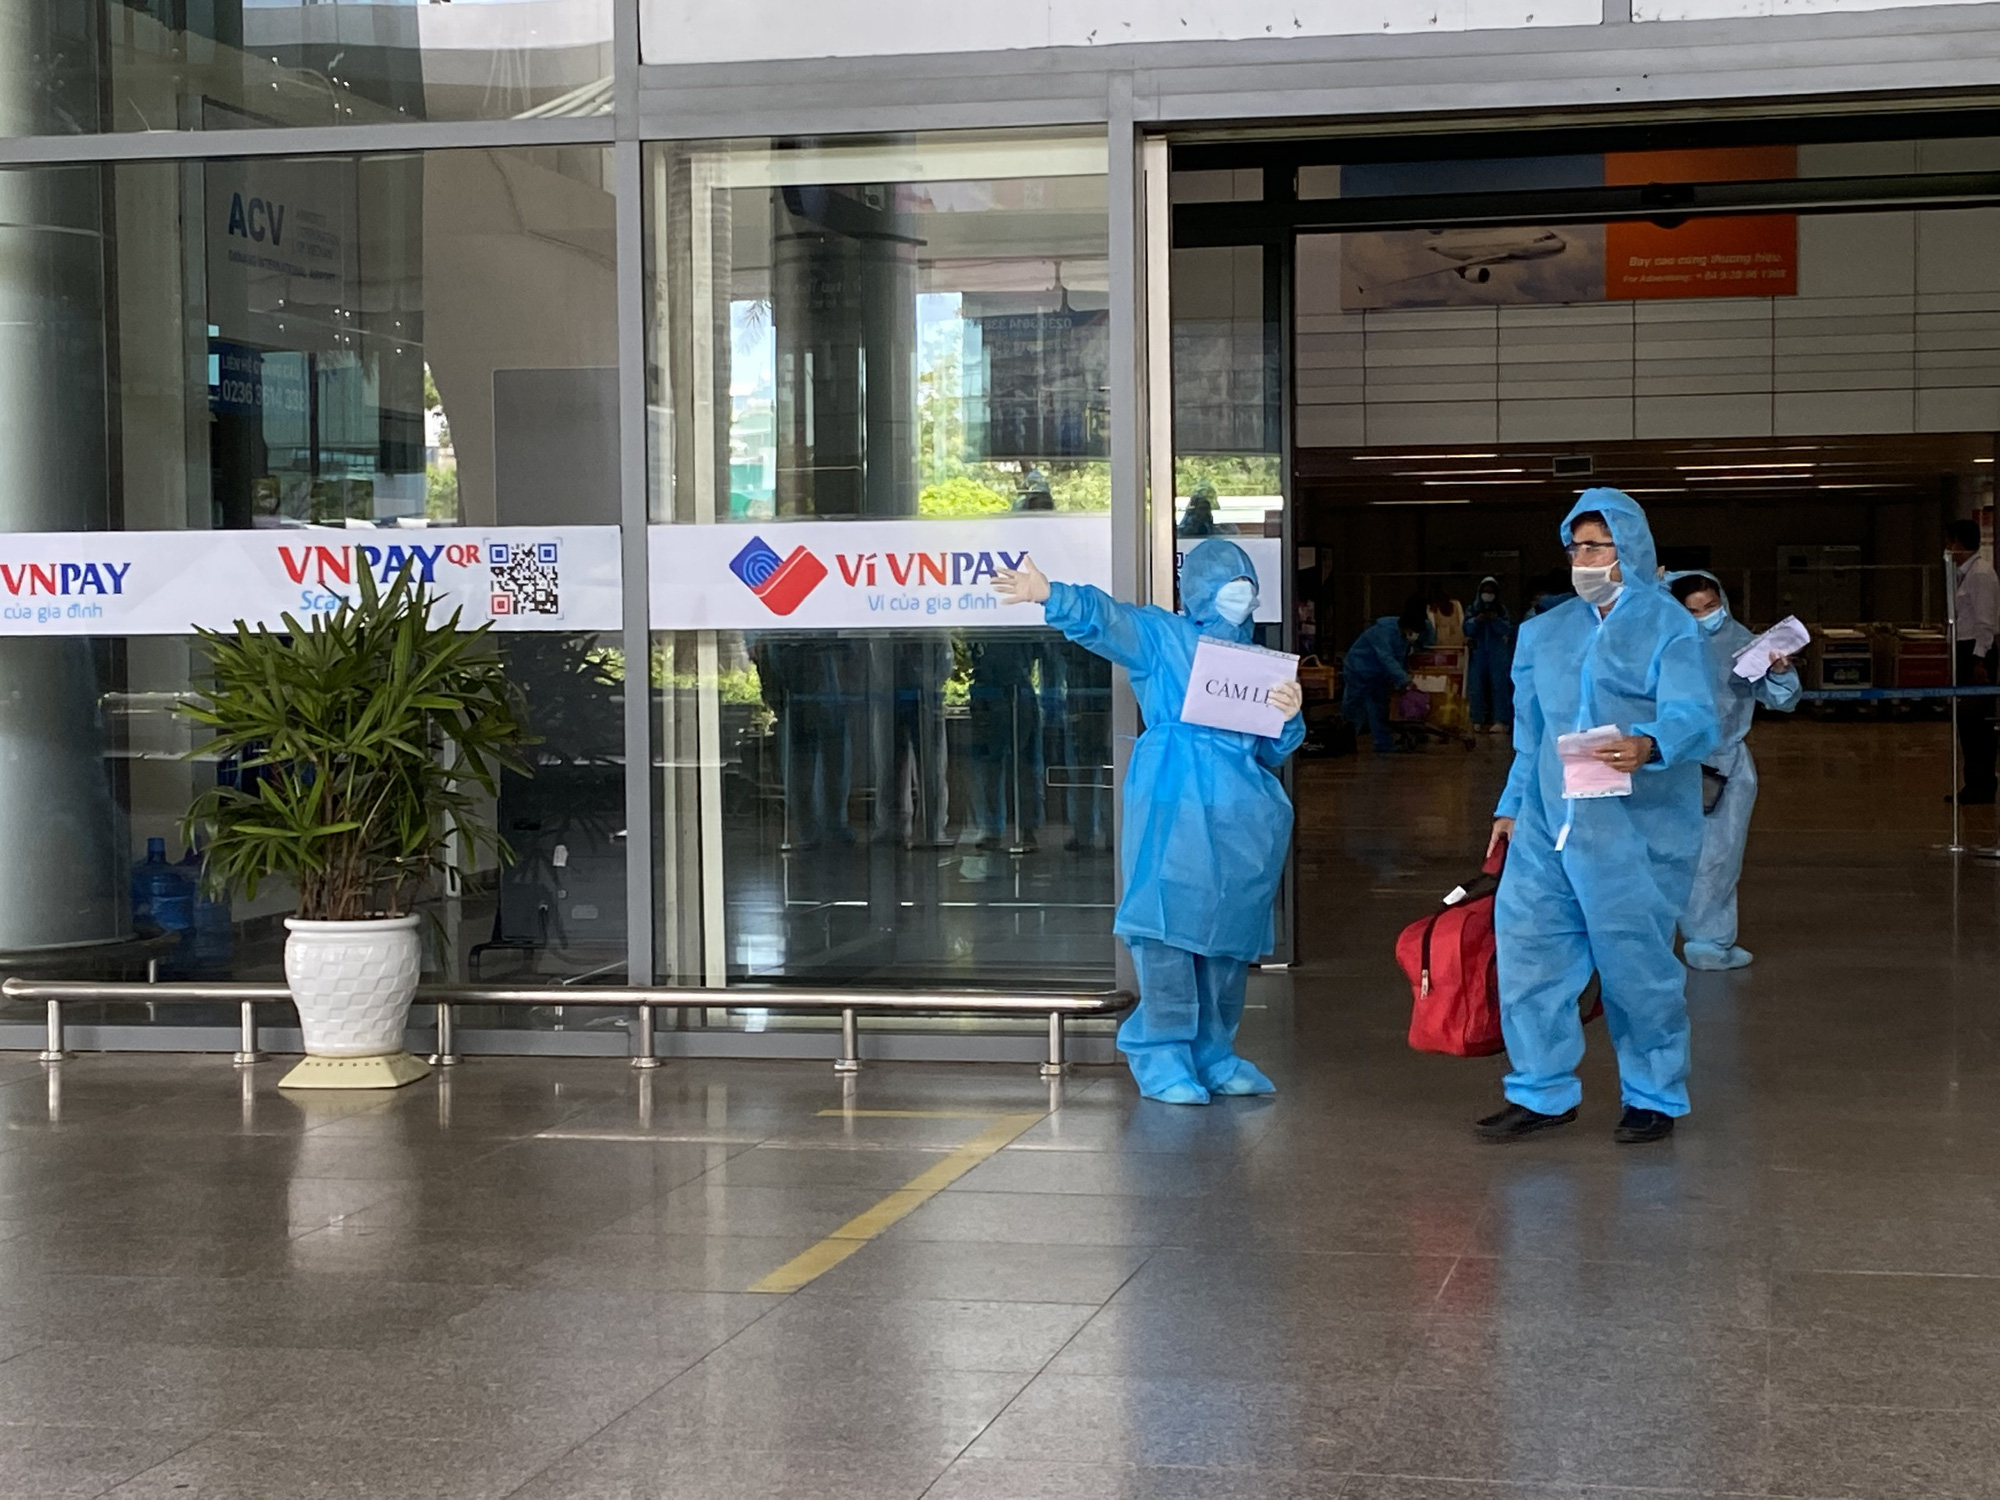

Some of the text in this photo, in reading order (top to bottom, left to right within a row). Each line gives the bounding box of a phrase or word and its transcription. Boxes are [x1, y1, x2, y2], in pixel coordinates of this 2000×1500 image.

[228, 191, 285, 247] ACV
[222, 379, 253, 405] 0236
[0, 562, 132, 596] VNPAY
[835, 553, 878, 587] Ví
[4, 601, 32, 619] của
[37, 602, 61, 624] gia
[299, 590, 346, 611] Sca
[890, 592, 920, 611] của
[925, 594, 952, 615] gia
